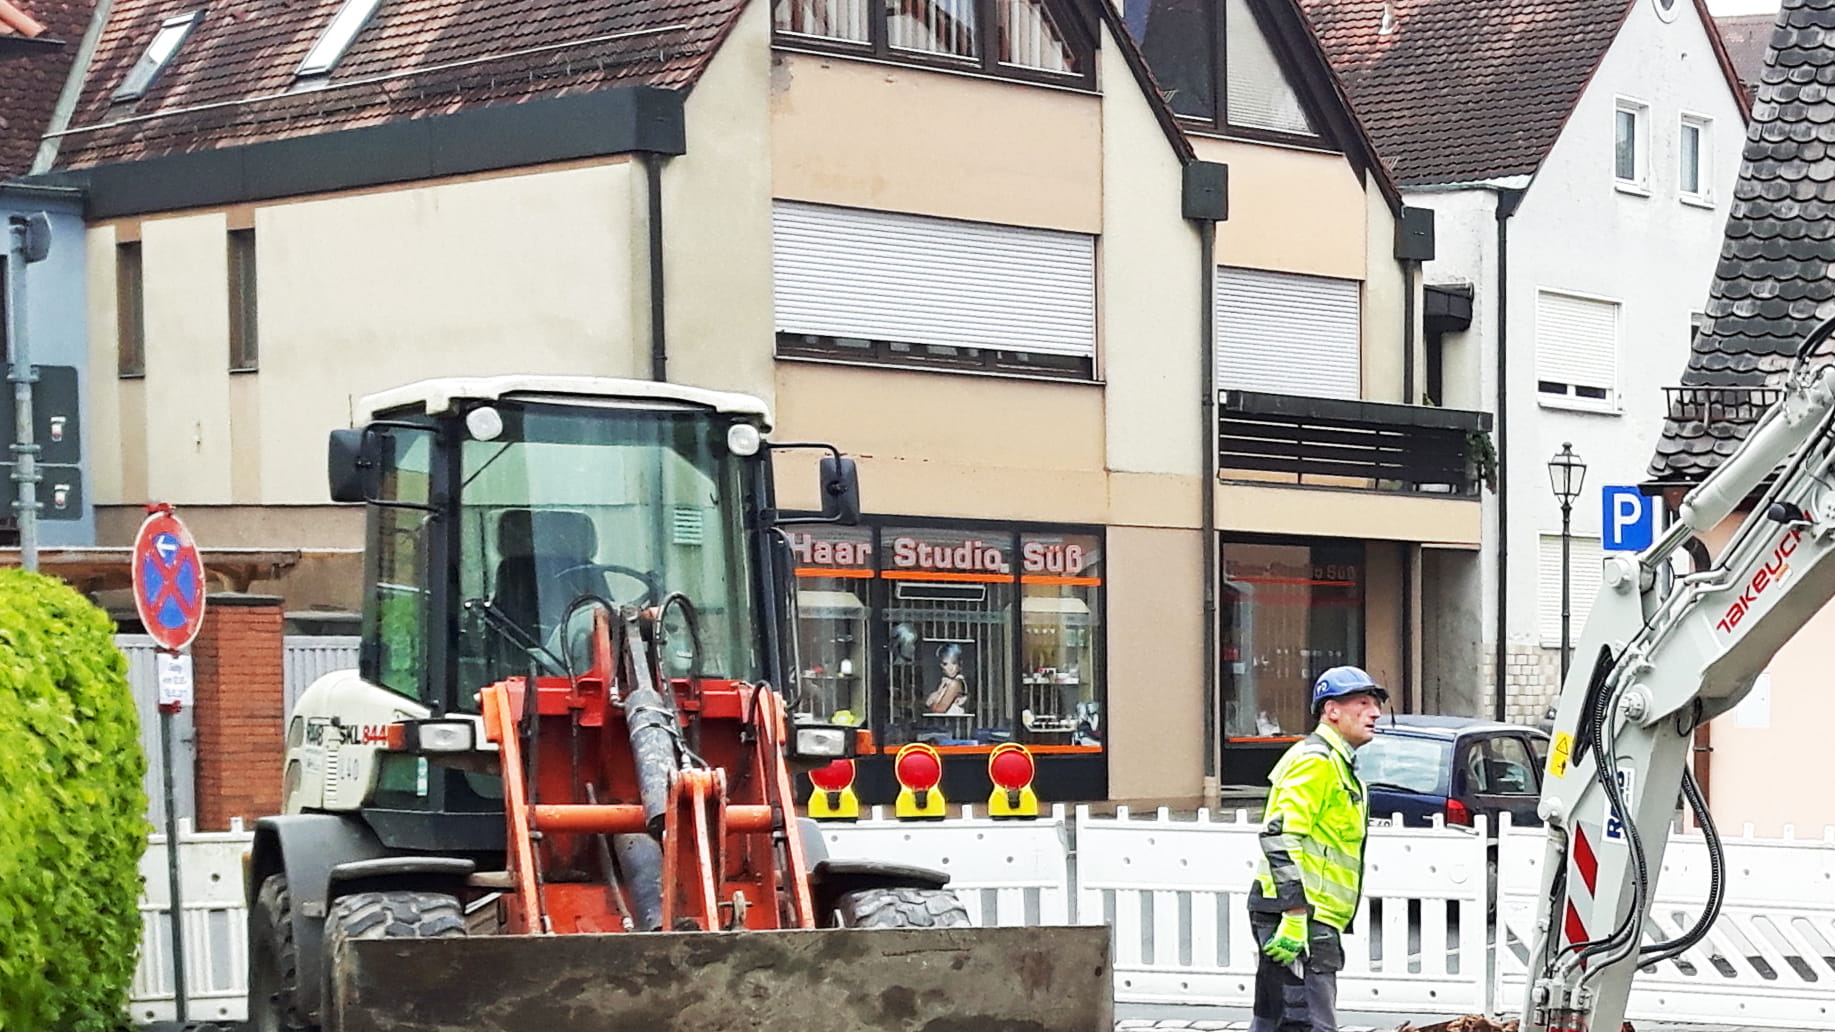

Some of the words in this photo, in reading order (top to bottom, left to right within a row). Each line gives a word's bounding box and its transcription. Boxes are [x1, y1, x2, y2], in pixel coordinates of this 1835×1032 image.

[1612, 492, 1642, 544] P
[787, 532, 873, 565] Haar
[1022, 542, 1083, 574] Süß
